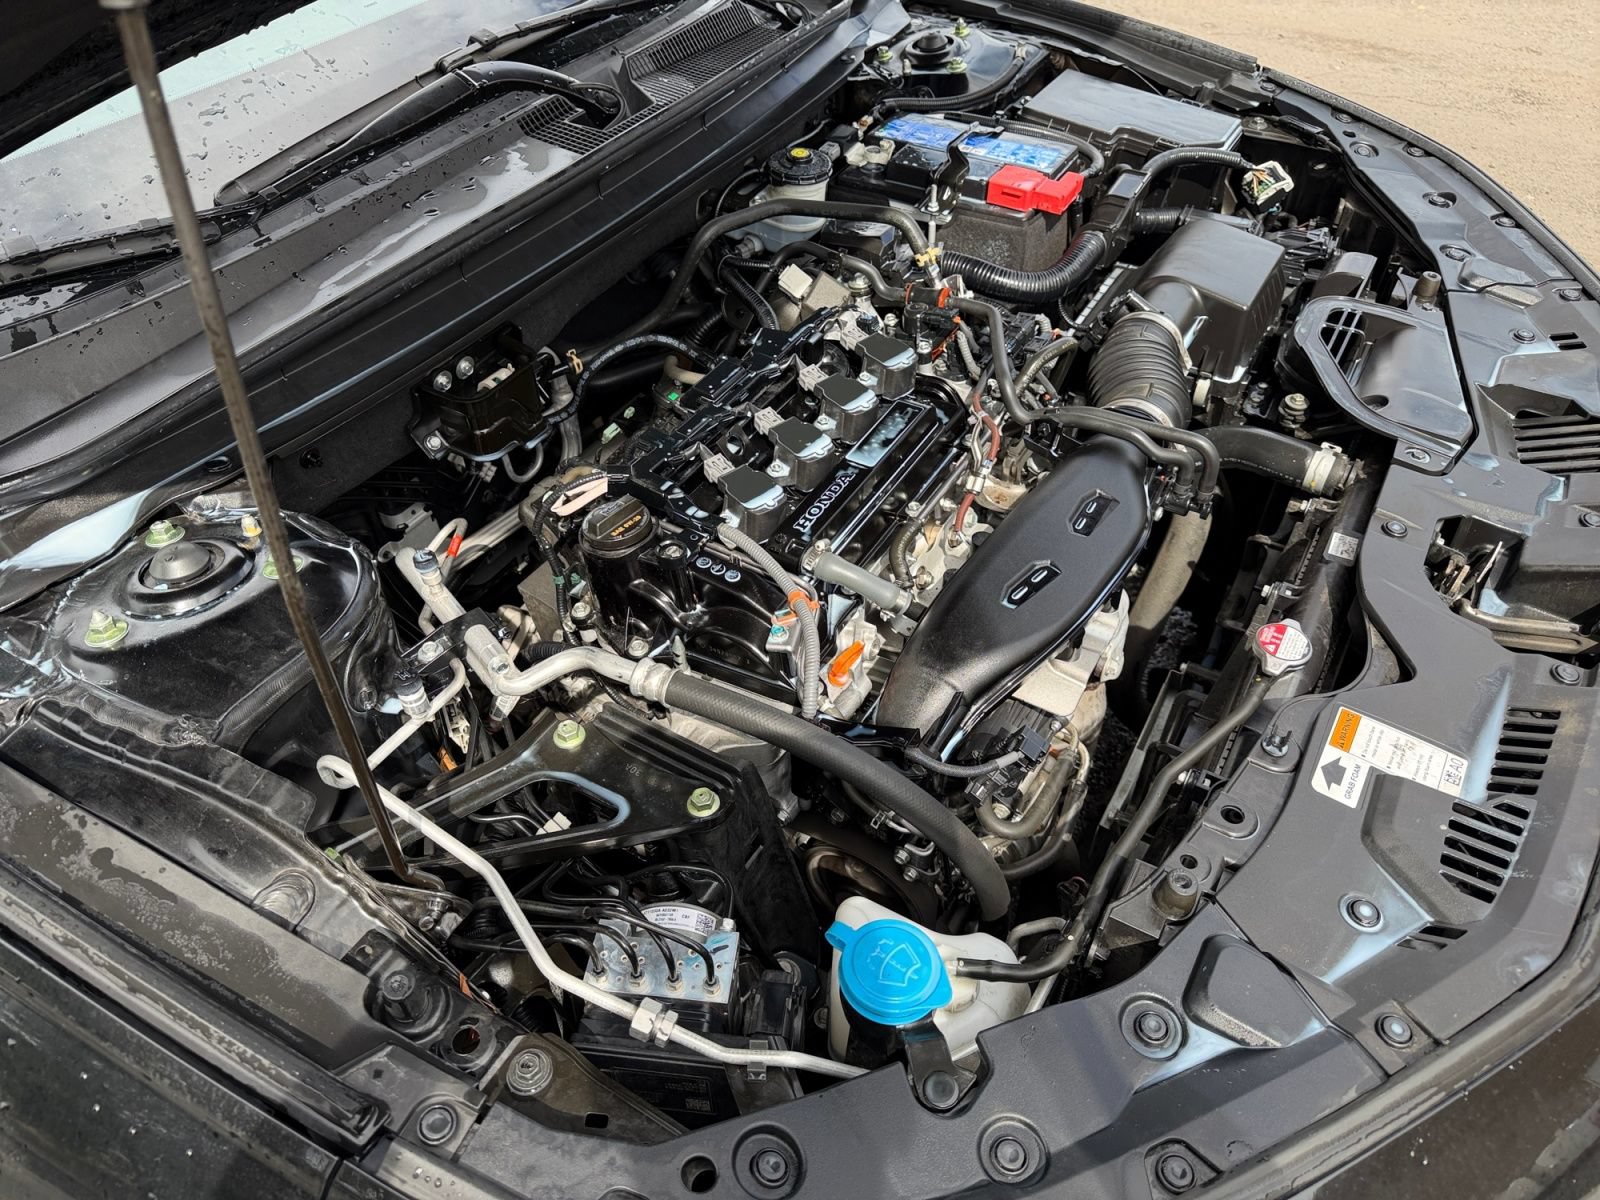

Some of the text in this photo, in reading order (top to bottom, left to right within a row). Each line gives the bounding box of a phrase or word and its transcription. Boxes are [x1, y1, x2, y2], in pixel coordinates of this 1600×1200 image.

[792, 471, 855, 533] HONDA
[1340, 713, 1355, 744] WARNING
[1344, 764, 1362, 800] GRAB FOAM
